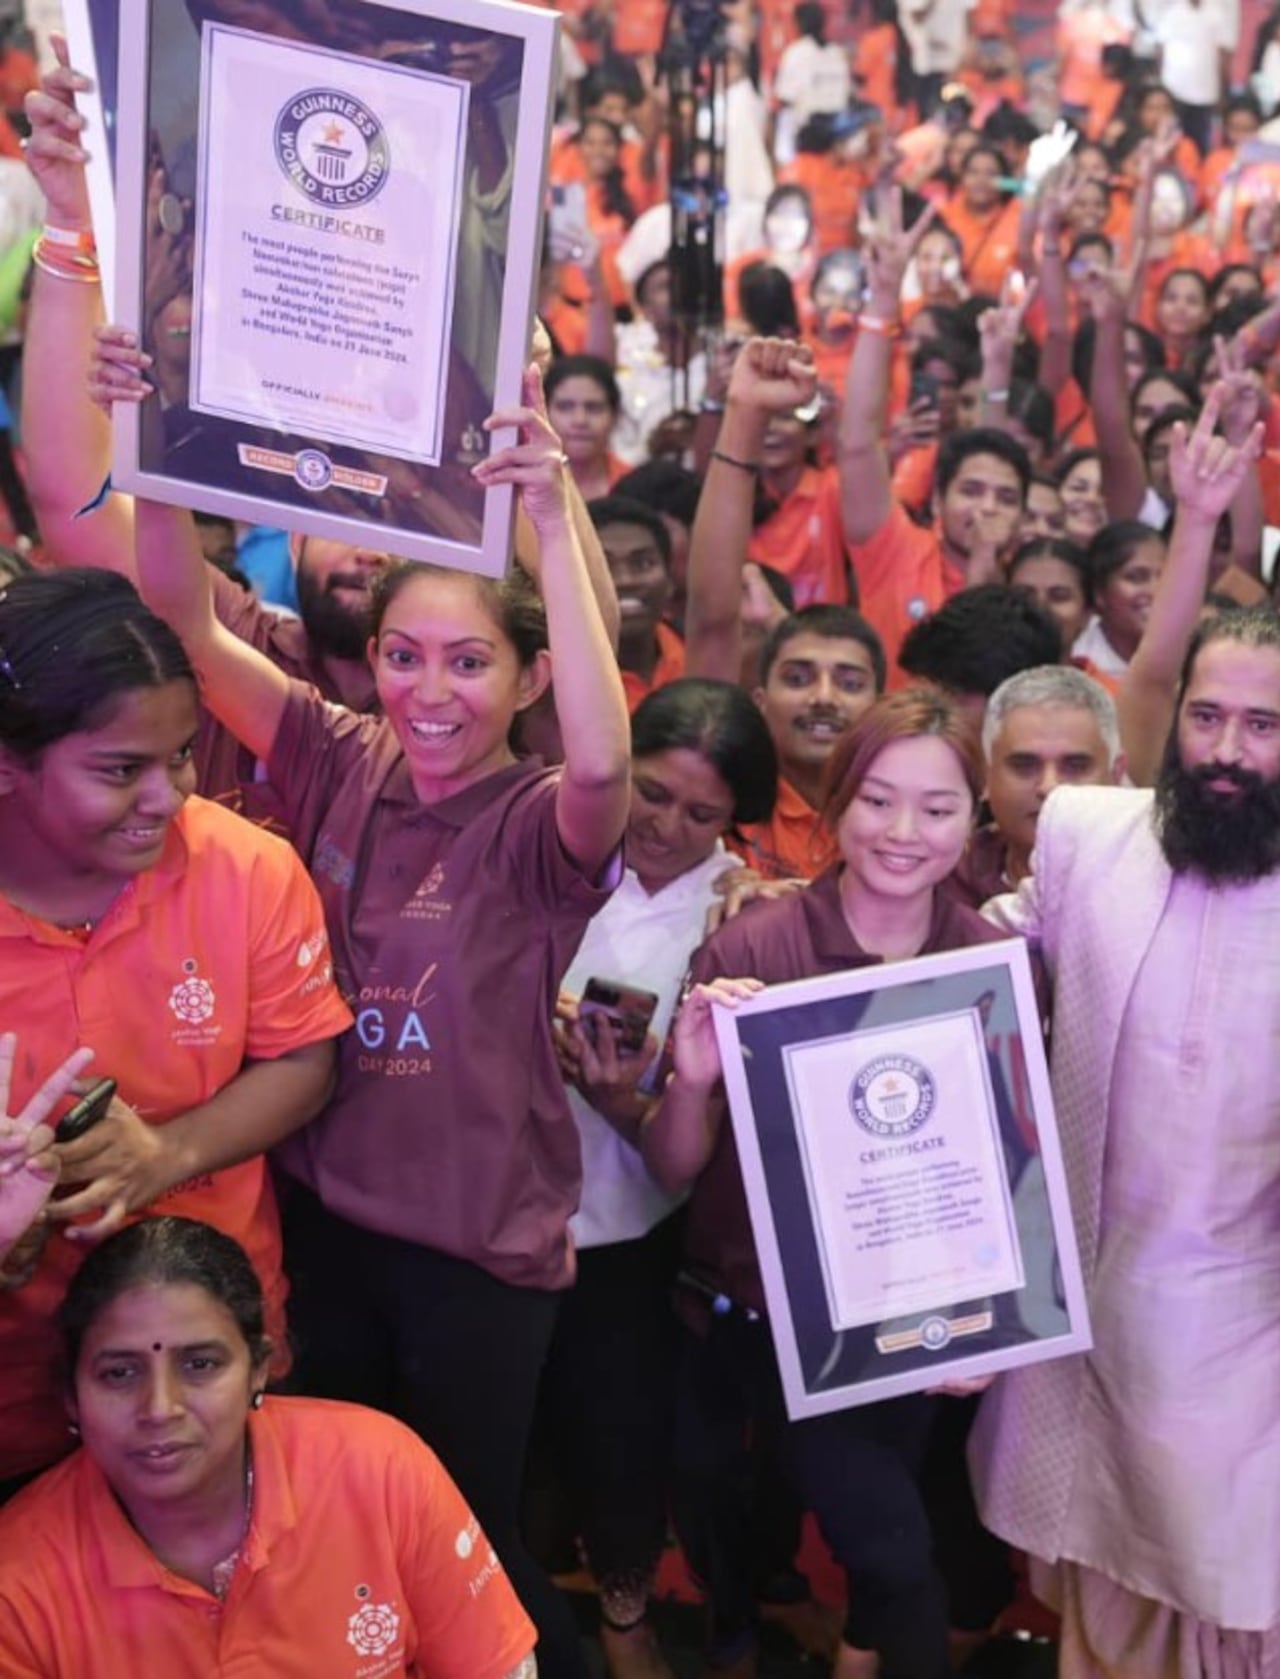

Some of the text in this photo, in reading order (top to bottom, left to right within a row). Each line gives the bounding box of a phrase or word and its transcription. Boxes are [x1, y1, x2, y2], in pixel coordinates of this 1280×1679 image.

[291, 95, 377, 137] GUINNESS
[280, 131, 385, 202] WORLD RECORDS
[271, 204, 386, 244] CERTIFICATE
[356, 1008, 430, 1051] GA
[385, 1058, 432, 1076] 2024
[858, 1058, 921, 1087] GUINNESS
[854, 1083, 933, 1134] WORLD RECORDS
[860, 1136, 945, 1164] CERTIFICATE
